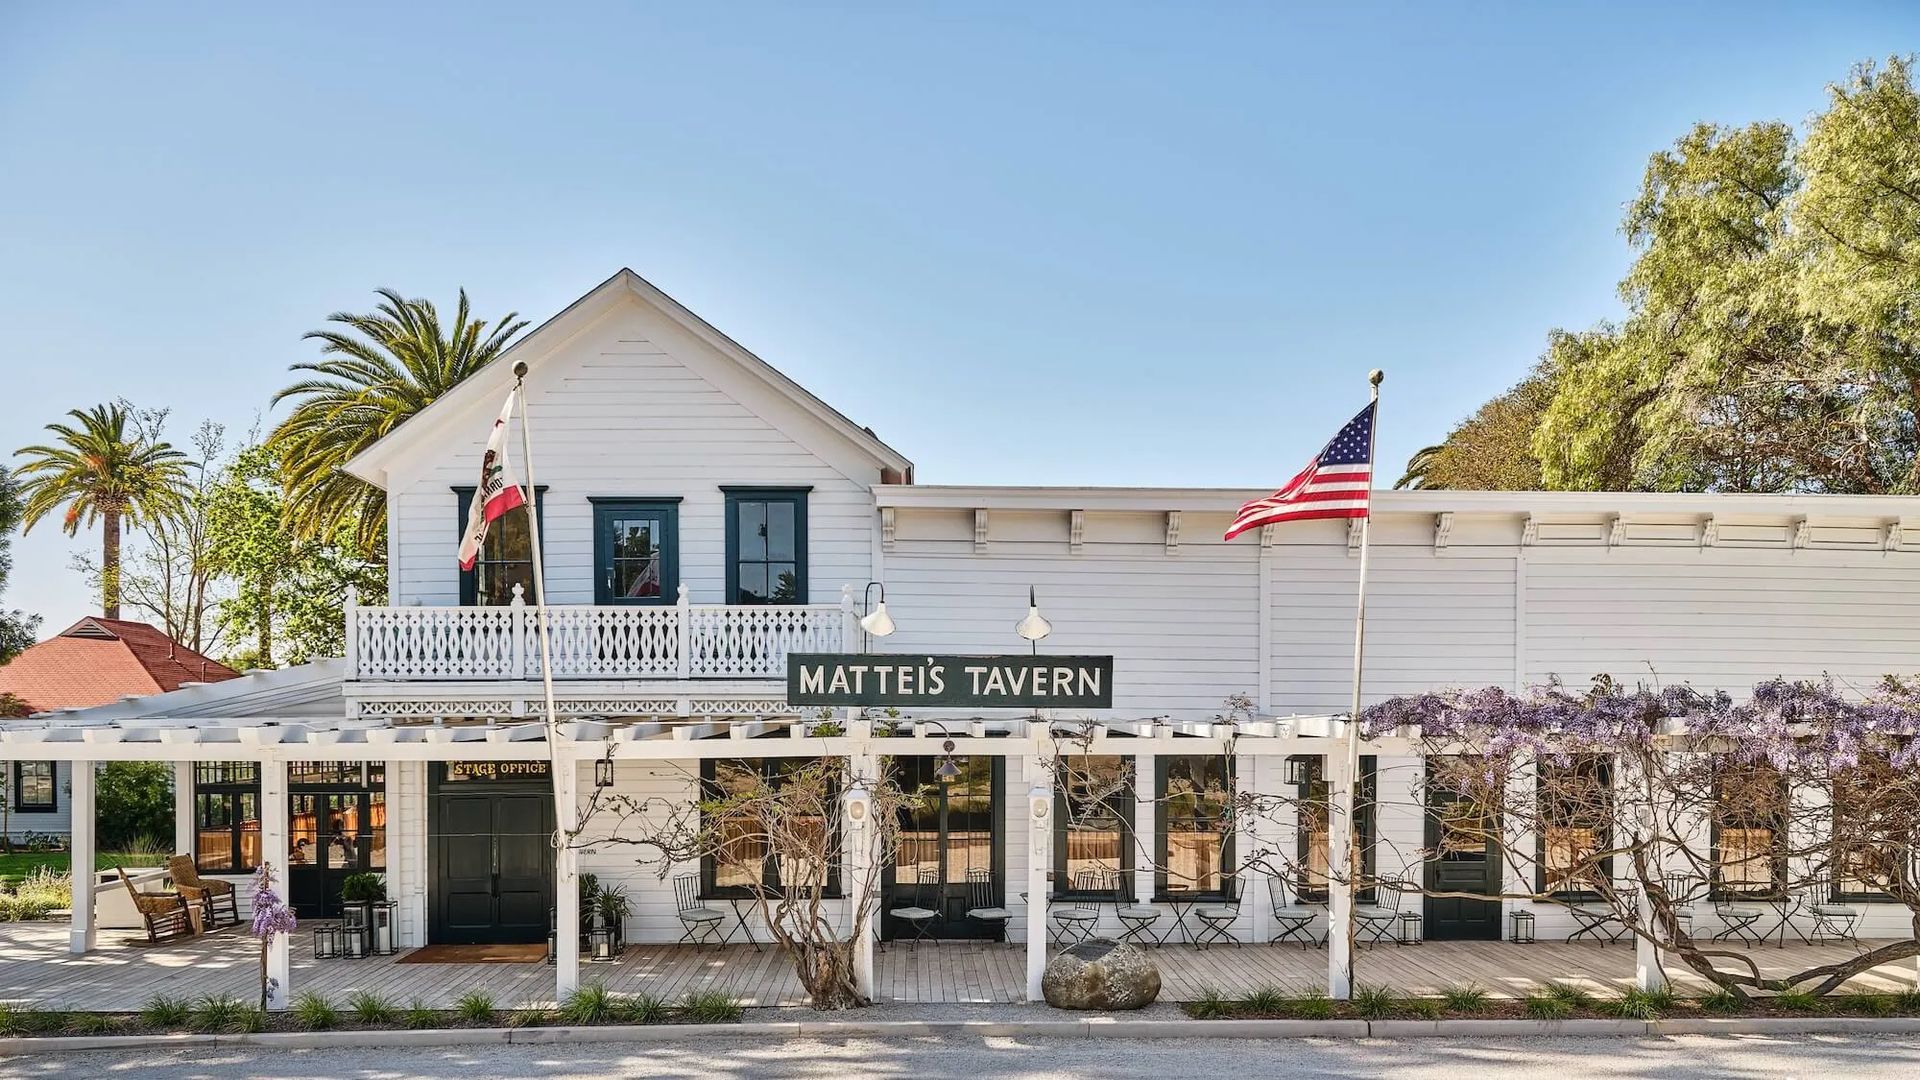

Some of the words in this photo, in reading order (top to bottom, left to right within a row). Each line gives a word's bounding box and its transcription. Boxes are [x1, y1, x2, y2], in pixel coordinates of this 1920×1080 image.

[799, 657, 945, 695] MATTEI'S
[964, 666, 1101, 696] TAVERN
[454, 763, 496, 775] STAGE
[500, 763, 546, 774] OFFICE
